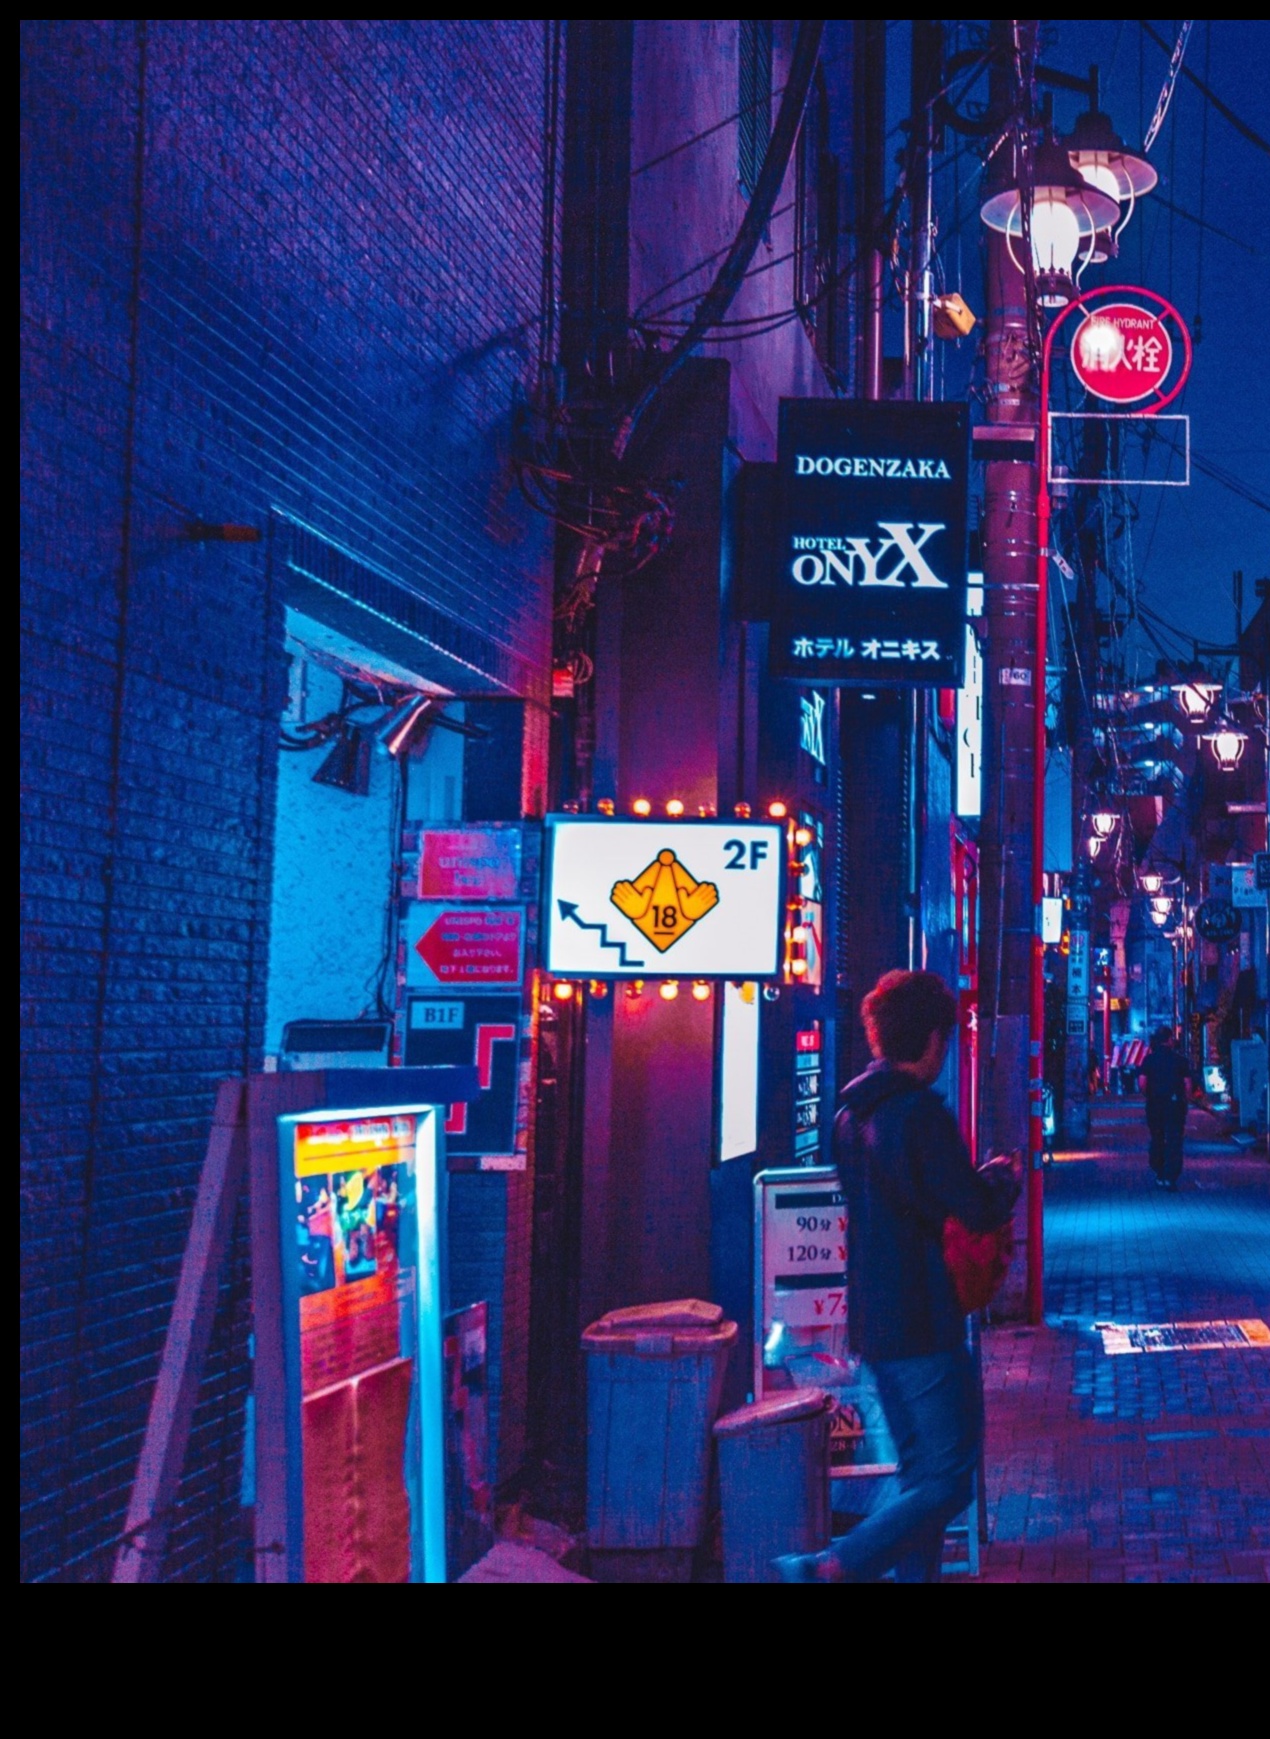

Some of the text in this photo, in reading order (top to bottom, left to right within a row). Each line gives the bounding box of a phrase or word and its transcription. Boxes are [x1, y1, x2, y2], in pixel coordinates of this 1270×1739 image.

[1114, 317, 1155, 330] HYDRANT
[796, 456, 951, 480] DOGENZAKA
[791, 521, 949, 588] ONYX
[793, 536, 846, 551] HOTEL
[793, 637, 941, 661] ホテル オニキス
[723, 839, 769, 871] 2F
[652, 904, 677, 929] 18
[424, 1007, 459, 1023] B1F
